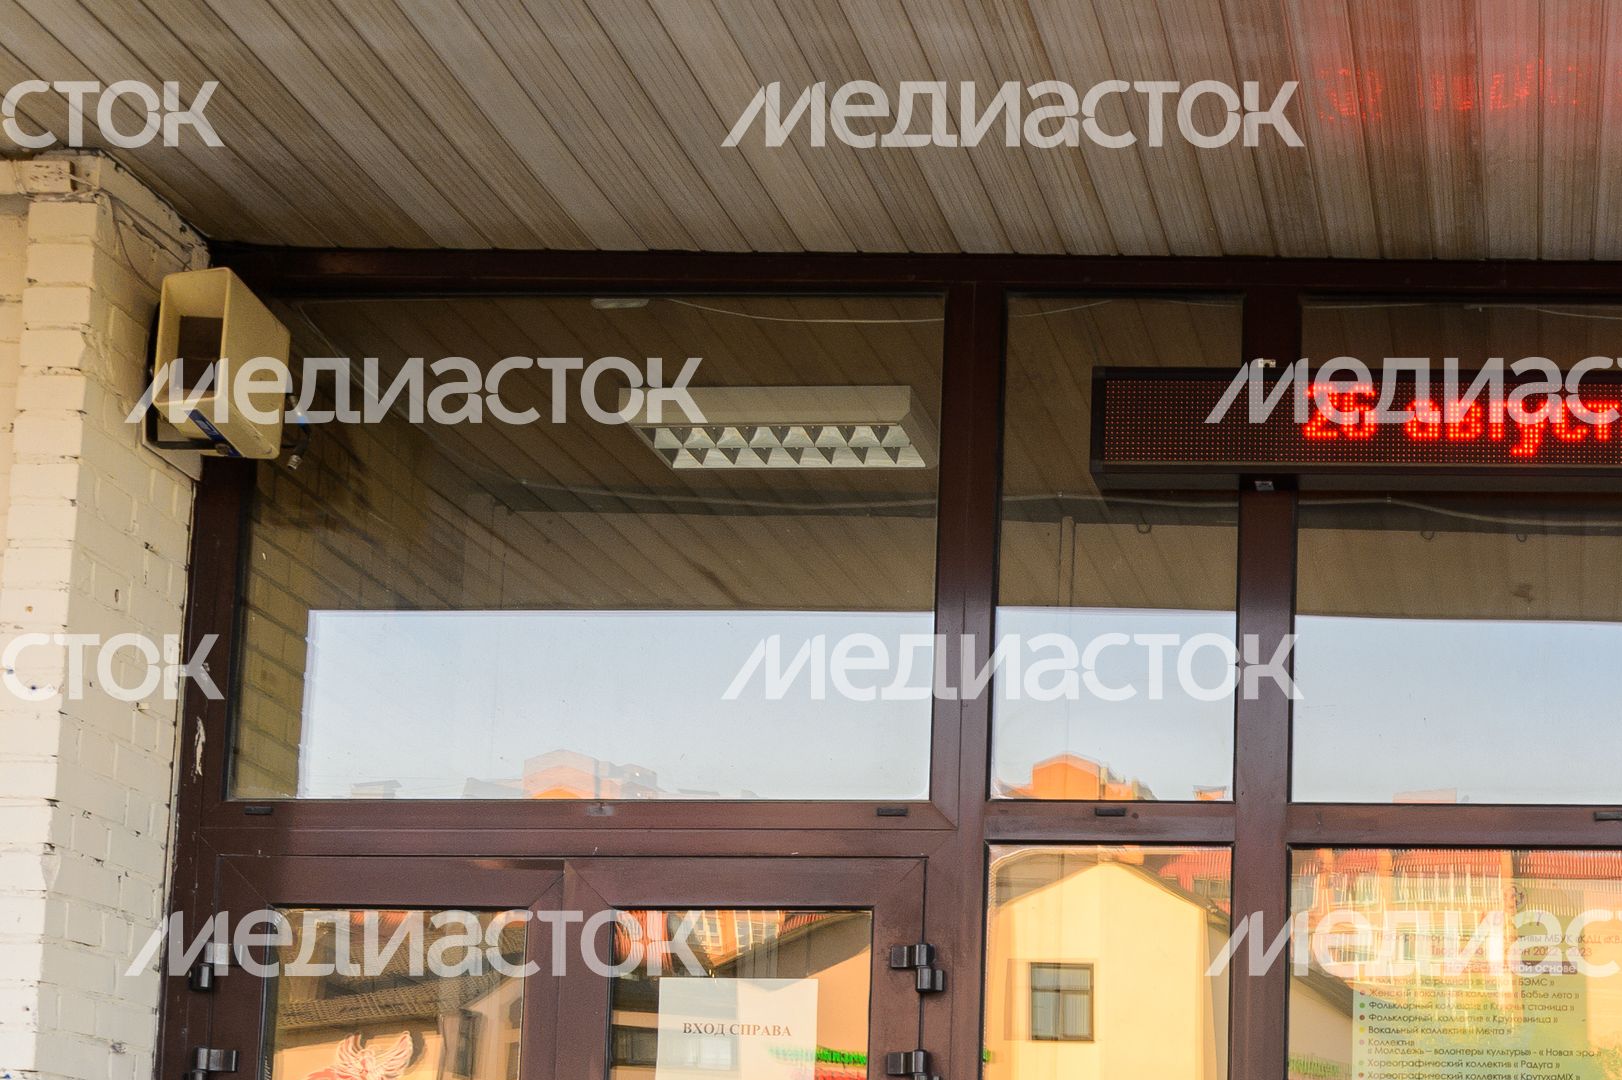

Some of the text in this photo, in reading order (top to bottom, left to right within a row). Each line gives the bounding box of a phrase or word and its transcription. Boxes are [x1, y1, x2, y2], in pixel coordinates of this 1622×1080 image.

[1303, 383, 1376, 437] 26
[1535, 964, 1577, 973] основе
[1518, 978, 1548, 986] БЭМС
[1369, 988, 1411, 997] Женский
[1521, 991, 1549, 999] Бабье
[1369, 1001, 1432, 1011] Фольклорный
[1369, 1014, 1432, 1023] Фольклорный
[682, 1022, 792, 1037] ВХОД СПРАВА
[1368, 1025, 1418, 1034] Вокальный
[1368, 1039, 1415, 1047] Коллектив
[1434, 1049, 1483, 1057] волонтеры
[1368, 1058, 1463, 1069] Хореографический
[1521, 1061, 1553, 1070] Радуга
[1368, 1071, 1463, 1080] Хореографический
